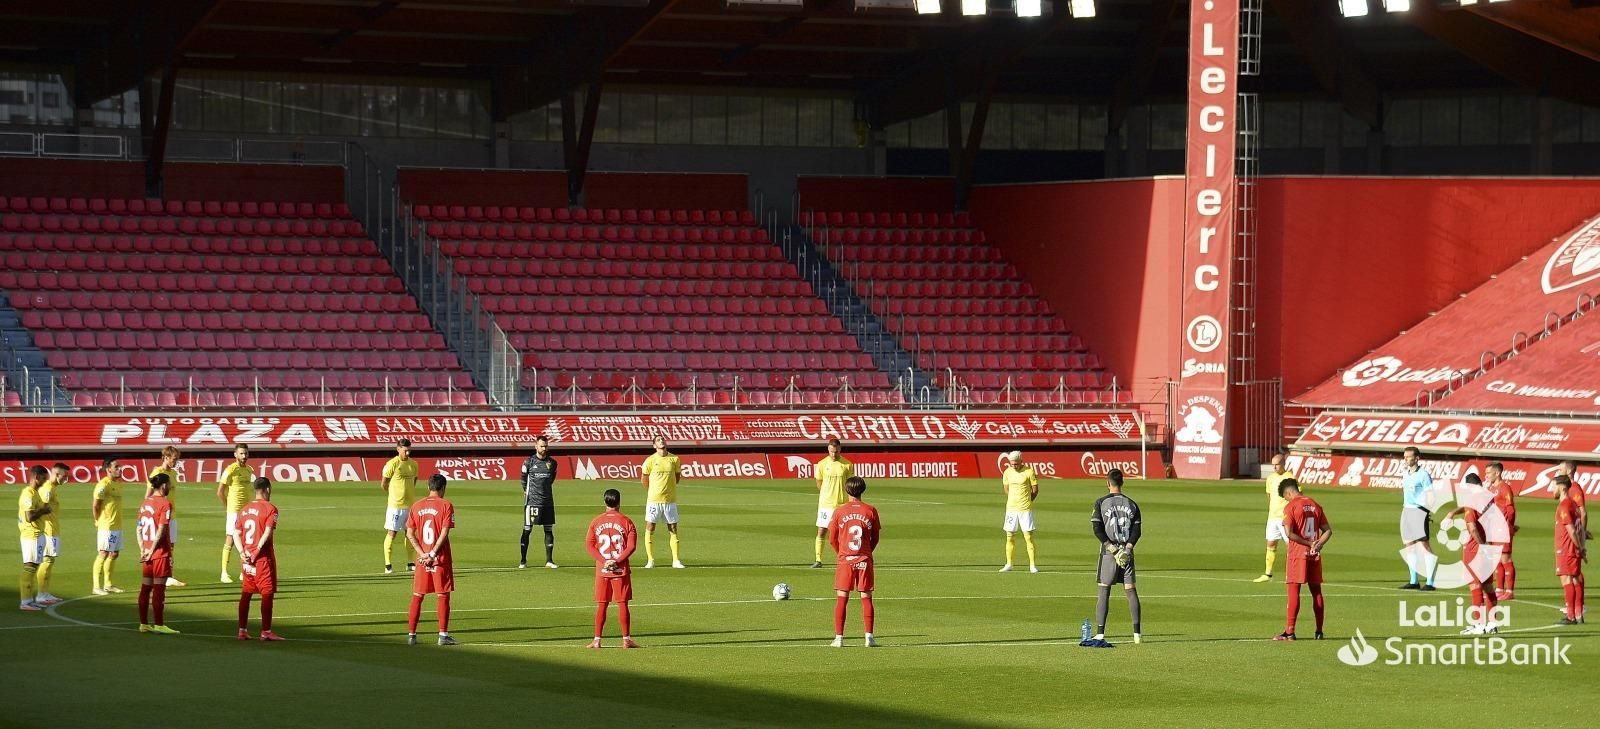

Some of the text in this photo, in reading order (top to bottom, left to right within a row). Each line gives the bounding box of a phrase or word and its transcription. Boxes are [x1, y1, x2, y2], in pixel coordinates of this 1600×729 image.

[1178, 395, 1225, 417] LA DESPENSA
[376, 418, 529, 433] SAN MIGUEL
[579, 416, 643, 424] FONTANERIA
[651, 416, 720, 424] CALEFACCION
[746, 418, 797, 428] reformas
[797, 415, 946, 439] CARRILLO
[985, 421, 1026, 437] Caja
[1053, 420, 1101, 434] Soria
[100, 424, 319, 445] PLAZA
[457, 434, 470, 443] DE
[473, 433, 538, 443] HORMIGON
[571, 425, 623, 441] JUSTO
[750, 429, 802, 438] construcción
[1341, 419, 1440, 443] CTELEC
[473, 458, 505, 467] TUTTO
[680, 459, 766, 477] aturales
[894, 463, 909, 477] DEL
[912, 462, 958, 477] DEPORTE
[1305, 457, 1331, 470] Grupo
[1364, 458, 1384, 475] LA
[1298, 468, 1335, 484] Herce
[530, 507, 539, 516] 13
[141, 516, 156, 541] 21
[244, 519, 256, 544] 2
[422, 519, 435, 545] 6
[848, 525, 863, 551] 3
[598, 534, 624, 560] 23
